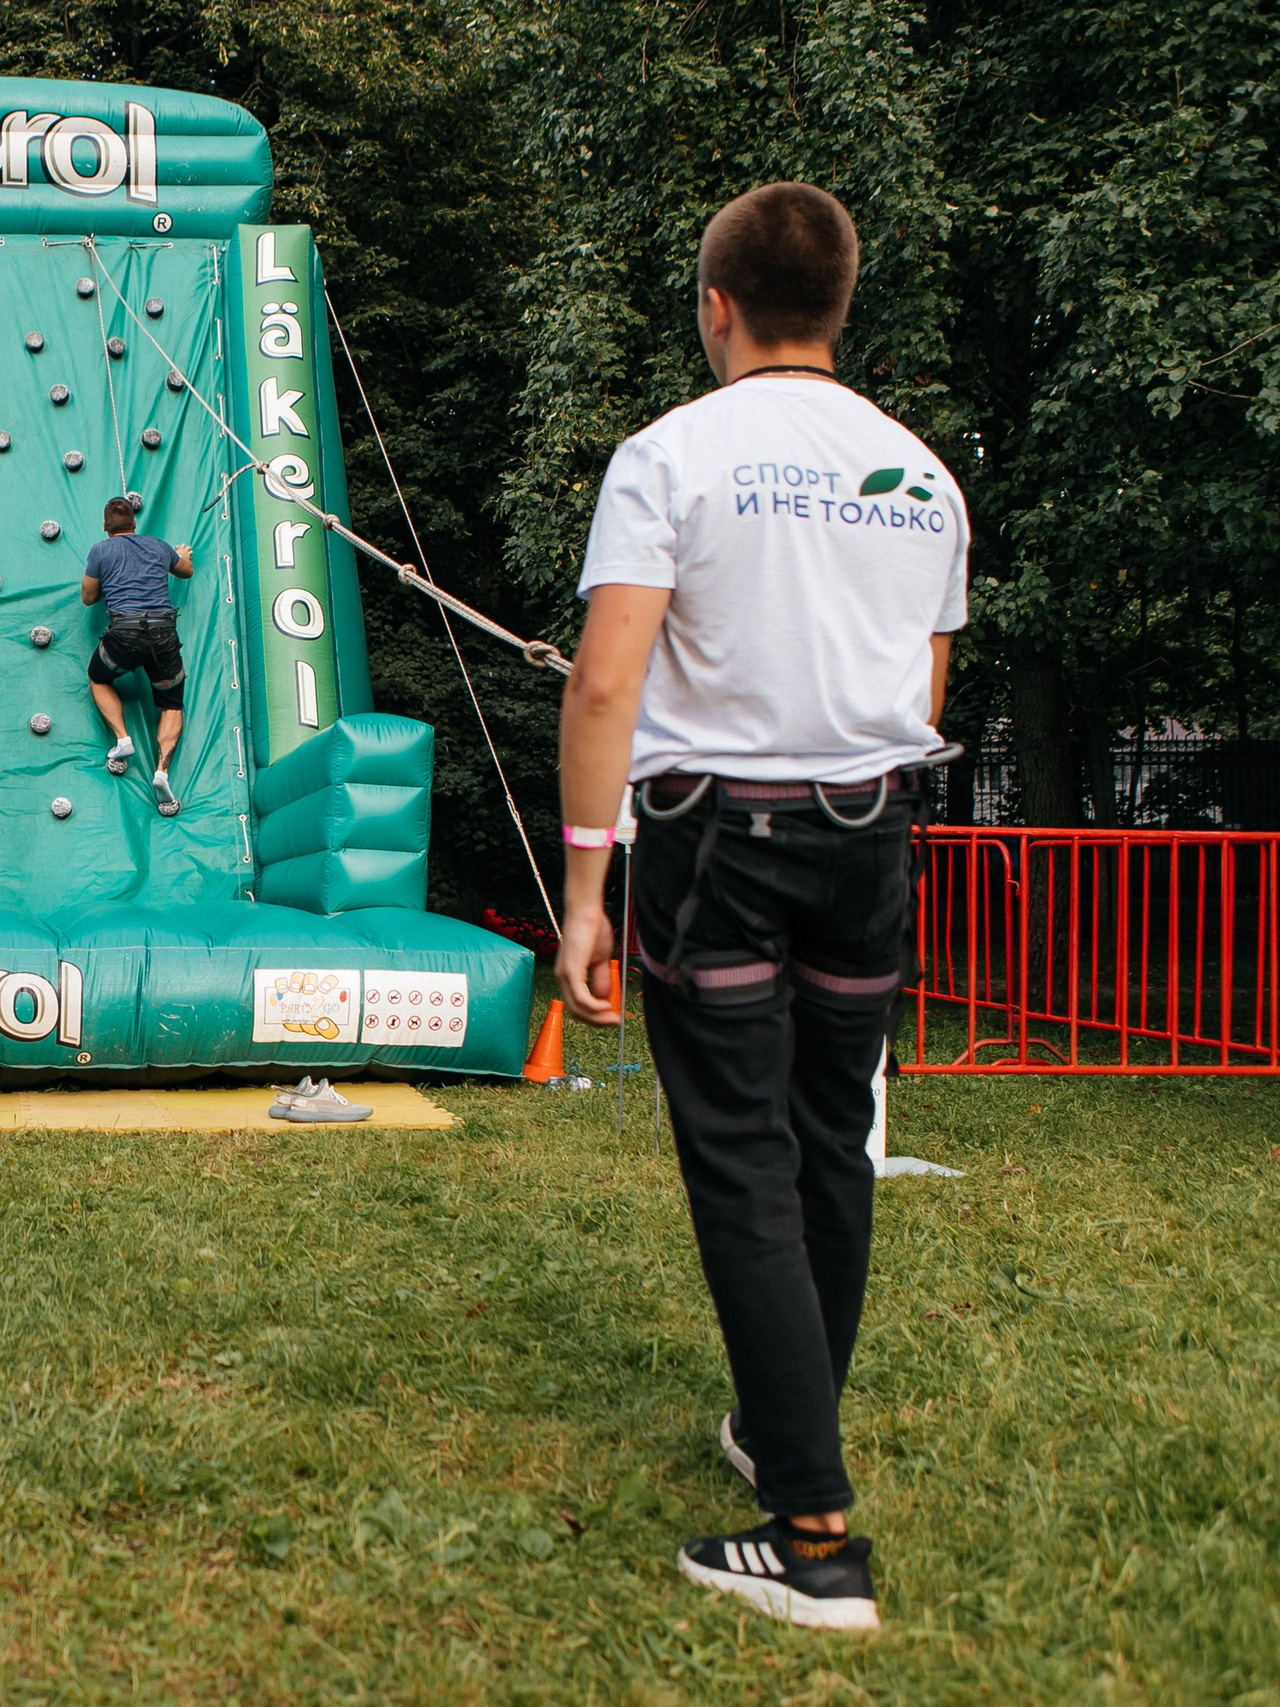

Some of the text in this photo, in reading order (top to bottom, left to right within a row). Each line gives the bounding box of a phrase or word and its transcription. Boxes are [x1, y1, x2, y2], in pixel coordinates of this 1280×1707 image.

[255, 232, 324, 730] Läkerol
[733, 463, 841, 494] СПОРТ
[736, 491, 945, 533] И НЕ ТОЛЬКО
